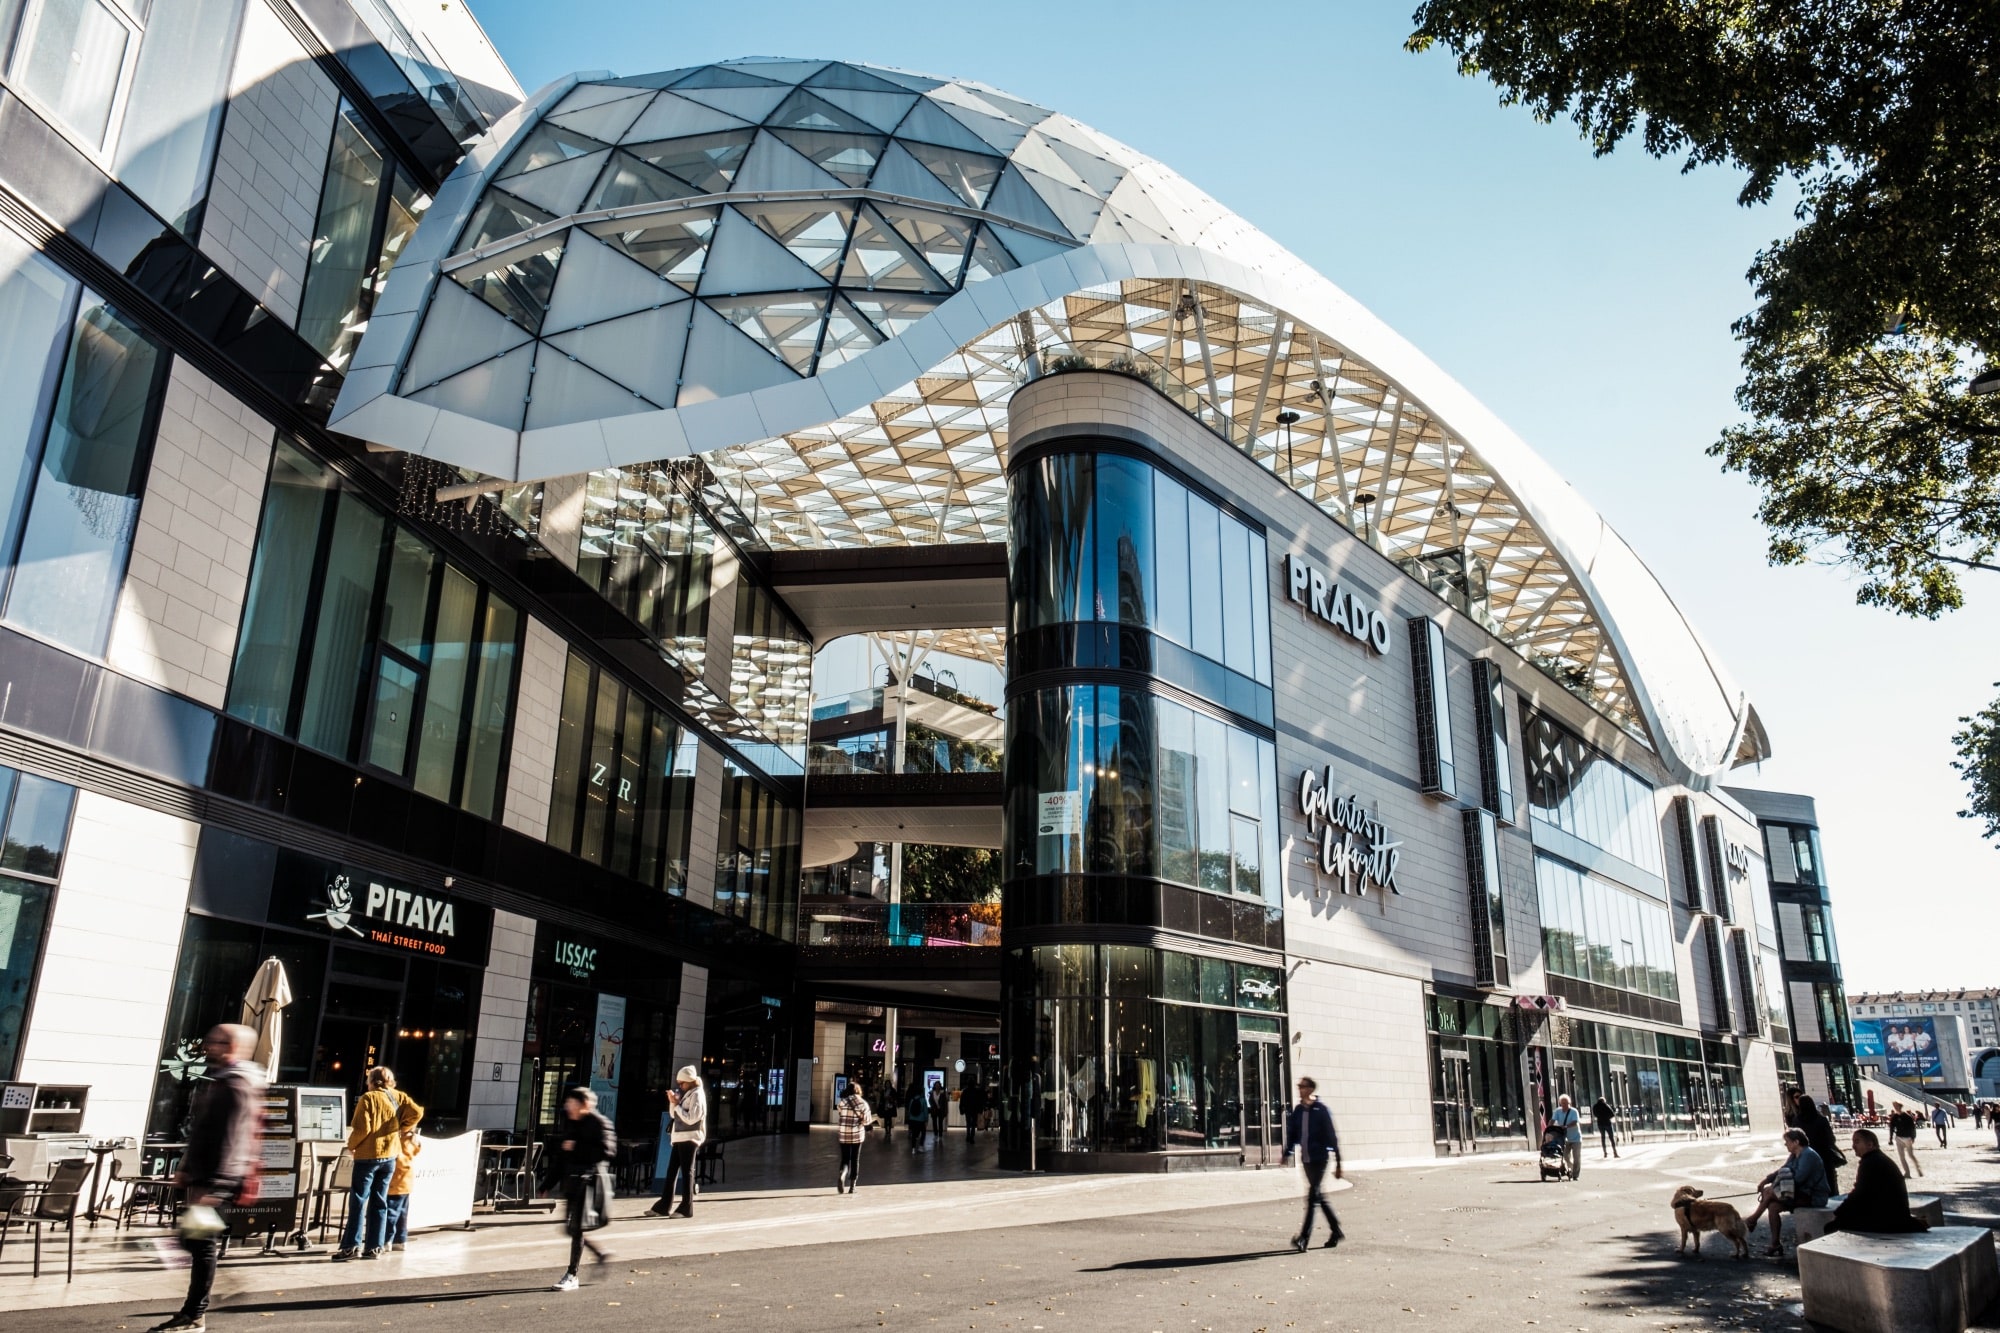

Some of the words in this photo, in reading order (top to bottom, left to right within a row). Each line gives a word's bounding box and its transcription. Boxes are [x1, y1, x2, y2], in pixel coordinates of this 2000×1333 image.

[1286, 553, 1391, 655] PRADO
[1298, 764, 1373, 838] Galeries
[1321, 823, 1404, 896] Lafayette
[365, 882, 454, 937] PITAYA
[371, 930, 392, 944] THAÏ
[393, 935, 422, 950] STREET
[424, 942, 446, 955] FOOD
[555, 940, 597, 971] LISSAC
